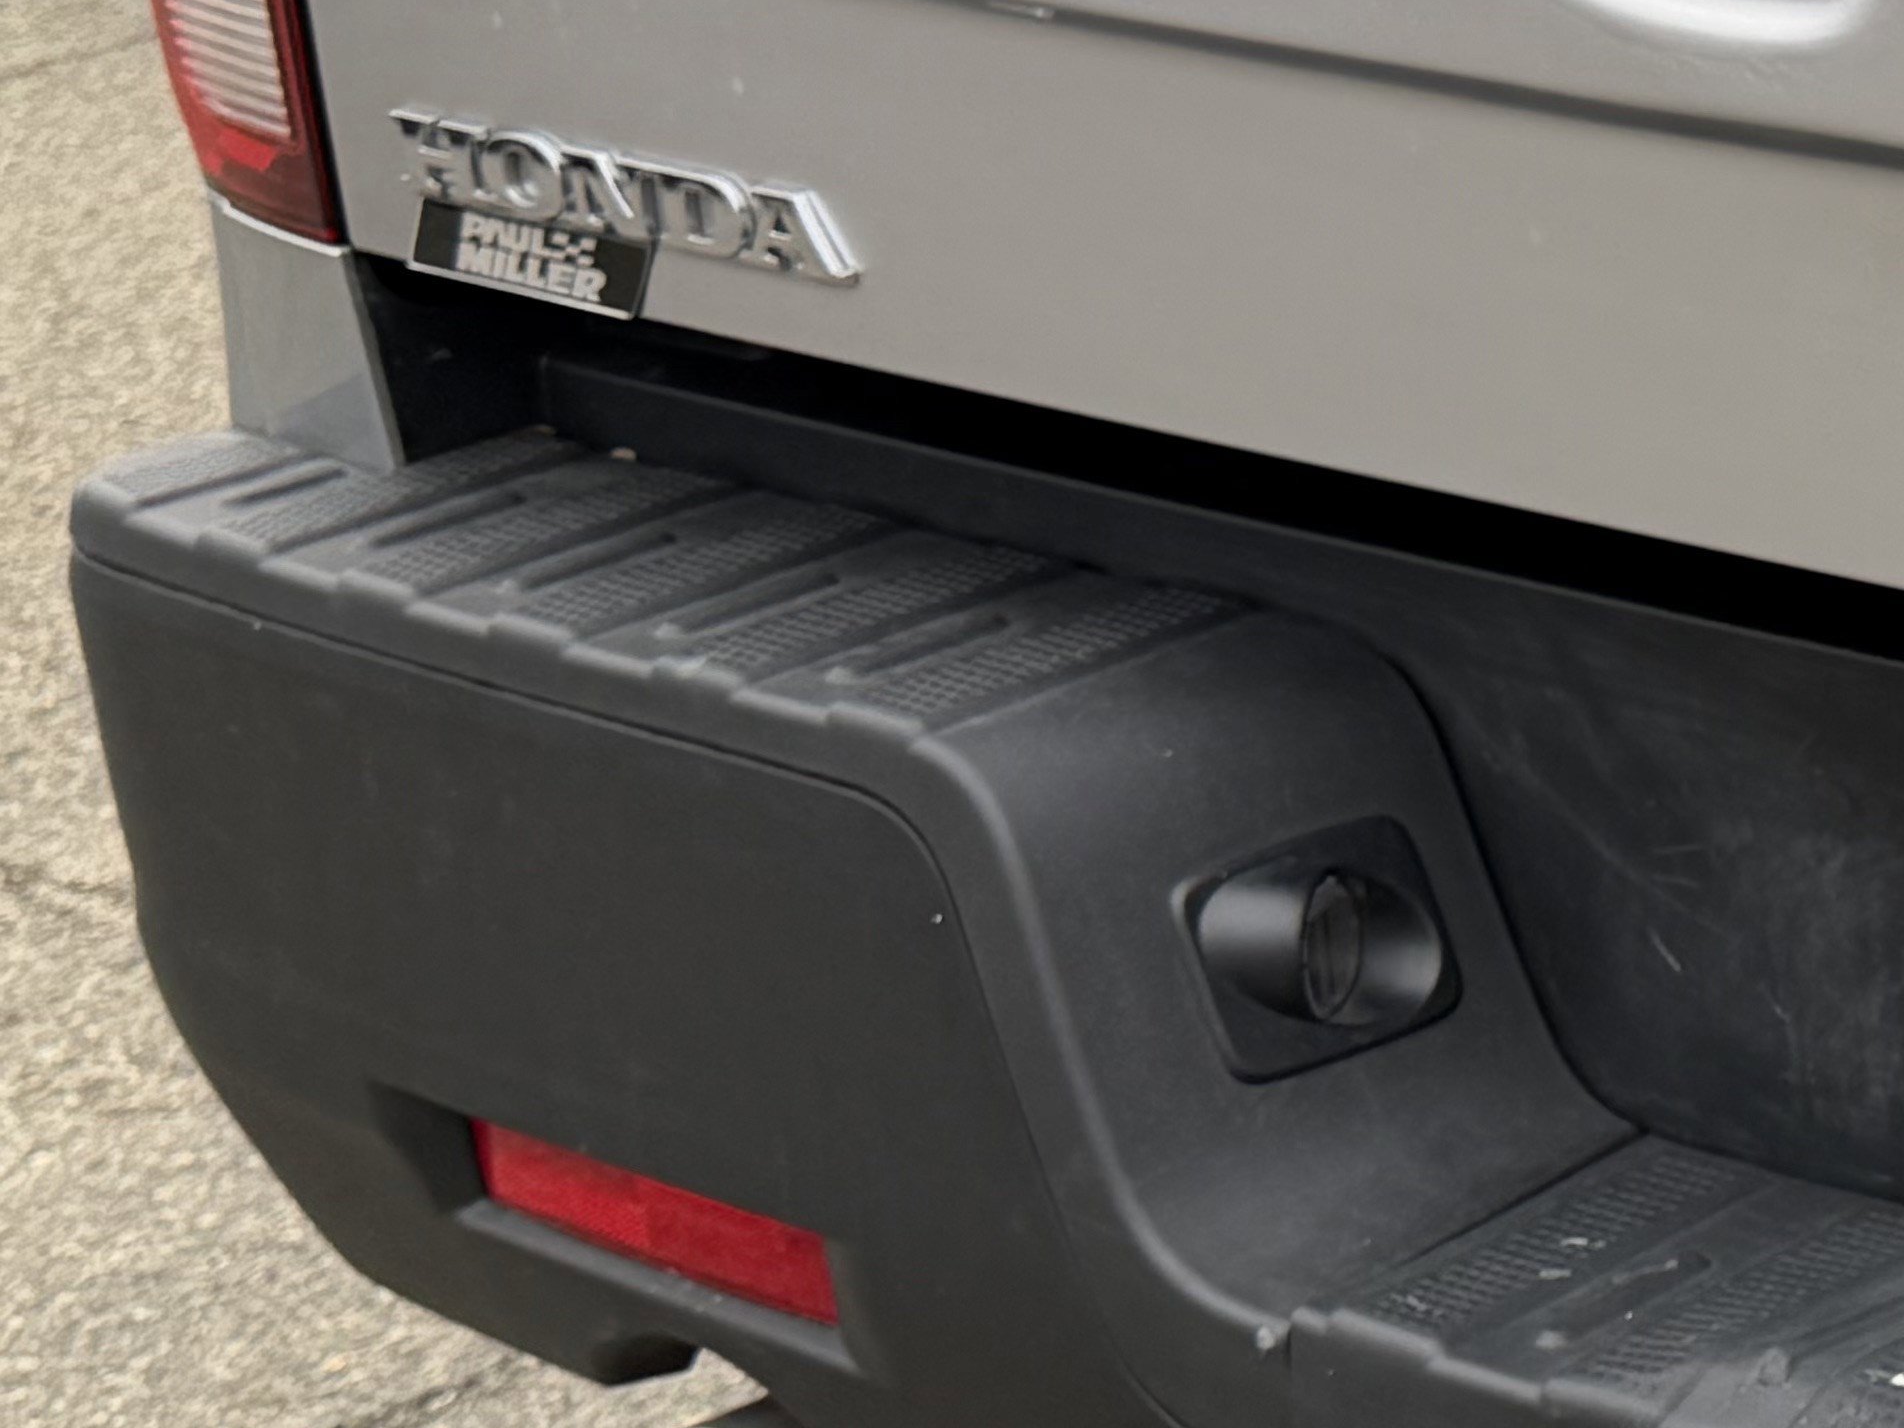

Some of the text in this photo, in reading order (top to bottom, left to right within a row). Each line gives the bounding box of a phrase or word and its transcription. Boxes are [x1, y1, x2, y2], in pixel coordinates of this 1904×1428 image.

[390, 108, 862, 286] HONDA
[459, 212, 553, 260] PAUL
[453, 240, 608, 304] MILLER
